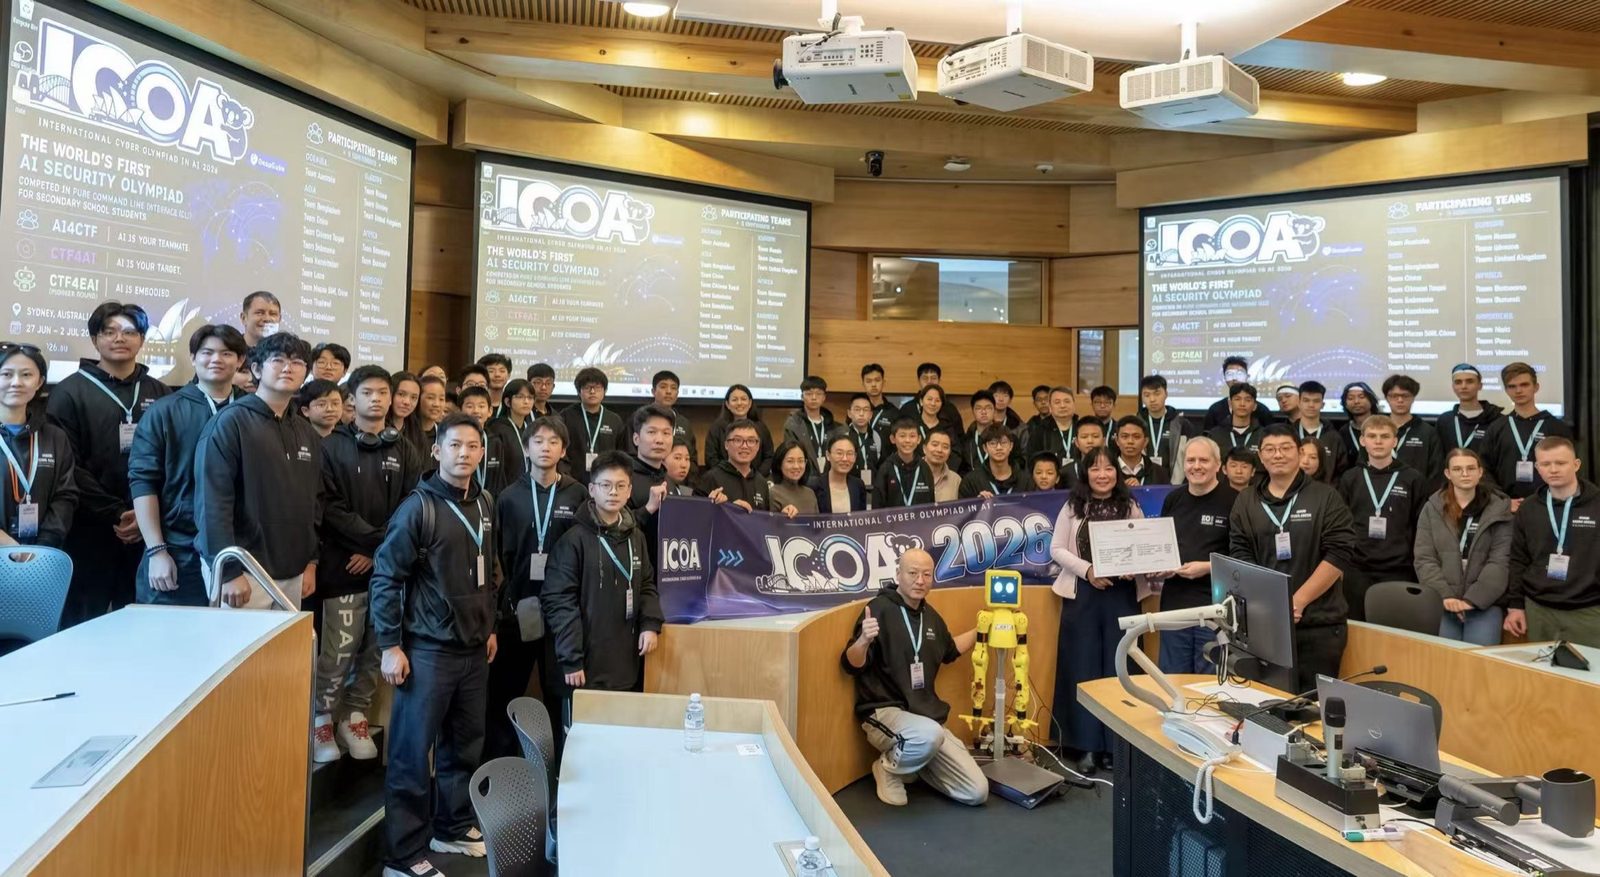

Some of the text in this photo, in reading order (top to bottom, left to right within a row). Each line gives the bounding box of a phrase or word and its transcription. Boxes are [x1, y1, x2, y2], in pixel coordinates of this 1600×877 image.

[40, 20, 235, 162] ICOA
[39, 117, 112, 144] INTERNATIONAL
[115, 139, 139, 152] CYBER
[143, 147, 178, 163] OLYMPIAD
[182, 157, 190, 166] IN
[328, 131, 376, 157] PARTICIPATING
[377, 149, 398, 166] TEAMS
[20, 133, 151, 178] THE WORLD'S FIRST
[20, 154, 184, 204] AI SECURITY OLYMPIAD
[19, 176, 59, 192] COMPETED
[62, 185, 70, 194] IN
[73, 187, 90, 199] PURE
[92, 192, 128, 206] COMMAND
[18, 189, 147, 220] FOR SECONDARY SCHOOL STUDENTS
[497, 176, 639, 244] ICOA
[1415, 197, 1491, 212] PARTICIPATING
[1495, 193, 1532, 206] TEAMS
[52, 219, 98, 237] AI4CTF
[118, 233, 125, 241] AI
[129, 234, 136, 243] IS
[139, 235, 156, 246] YOUR
[1160, 212, 1305, 265] ICOA
[487, 246, 574, 262] THE WORLD'S FIRST
[117, 258, 124, 267] AI
[127, 259, 134, 268] IS
[136, 260, 155, 271] YOUR
[487, 258, 498, 267] AI
[502, 259, 549, 271] SECURITY
[553, 264, 599, 276] OLYMPIAD
[49, 273, 99, 291] CTF4EAI
[116, 283, 123, 293] AI
[126, 285, 132, 294] IS
[1152, 280, 1235, 292] THE WORLD'S FIRST
[1152, 289, 1262, 303] AI SECURITY OLYMPIAD
[27, 307, 55, 318] SYDNEY,
[26, 324, 35, 332] 27
[37, 325, 51, 334] JUN
[813, 518, 882, 528] INTERNATIONAL
[887, 514, 915, 522] CYBER
[920, 508, 964, 519] OLYMPIAD
[662, 539, 701, 570] ICOA
[931, 512, 1053, 583] 2026
[766, 533, 898, 592] ICOA
